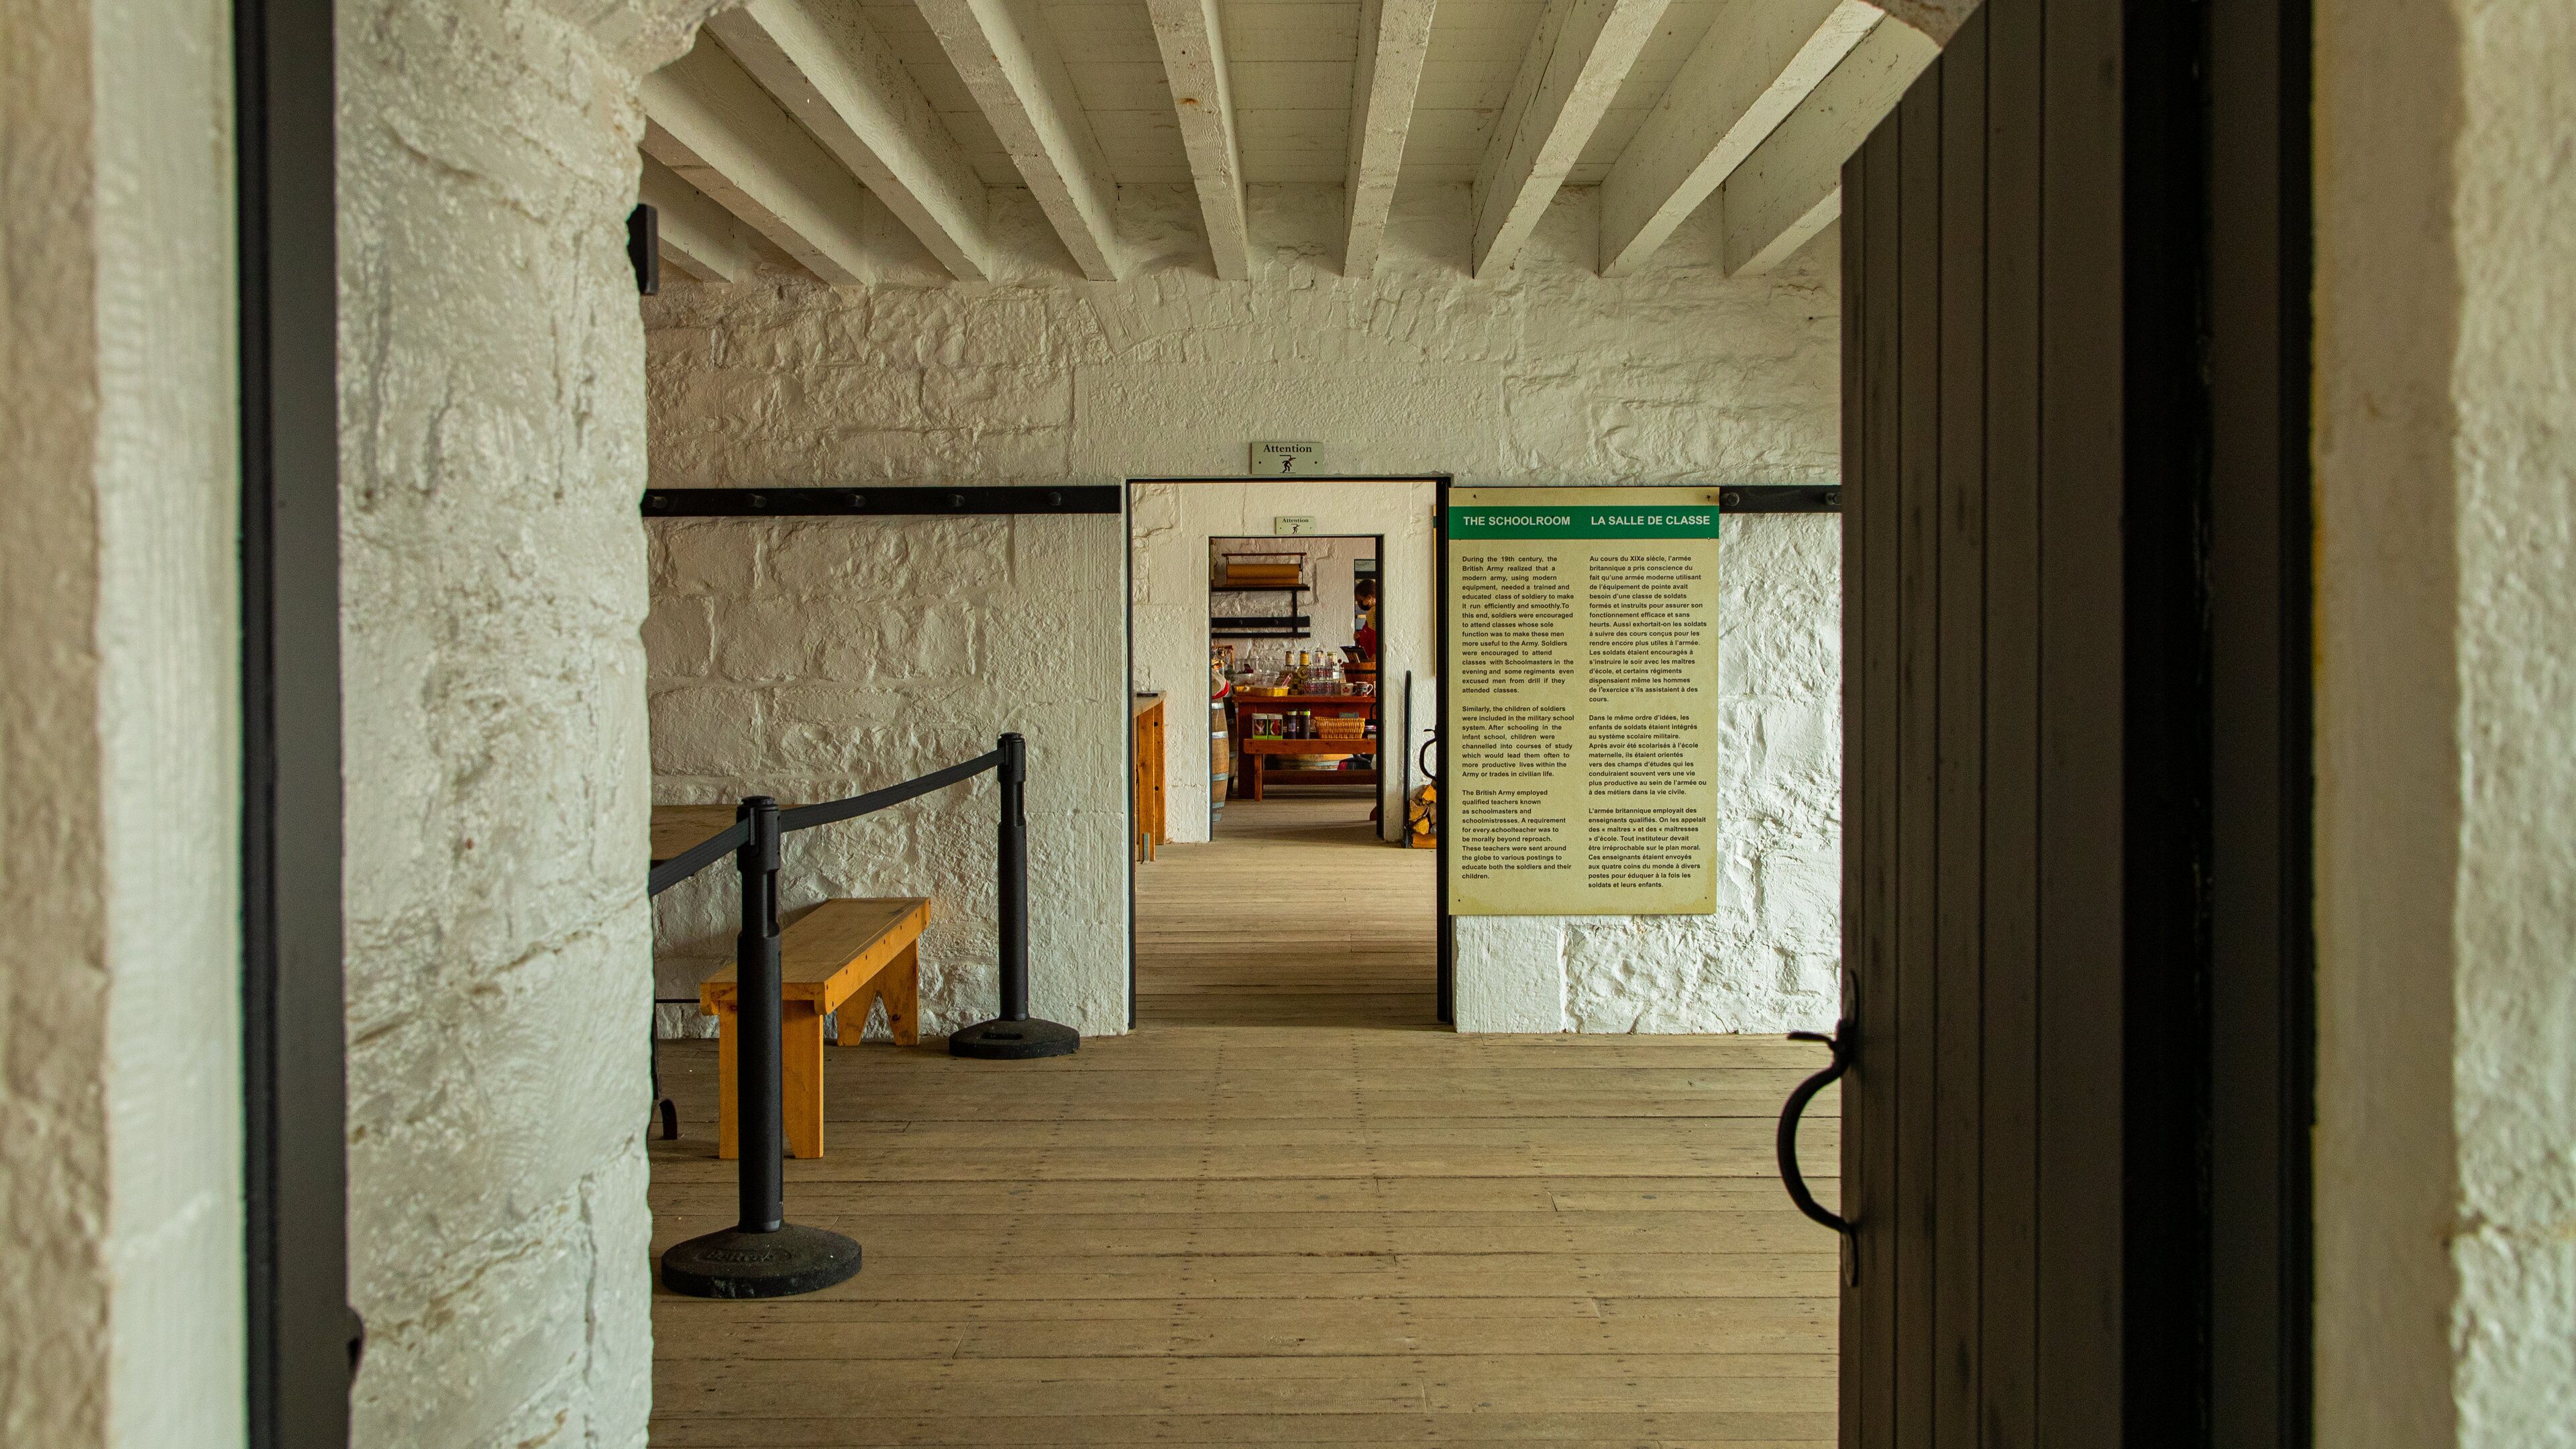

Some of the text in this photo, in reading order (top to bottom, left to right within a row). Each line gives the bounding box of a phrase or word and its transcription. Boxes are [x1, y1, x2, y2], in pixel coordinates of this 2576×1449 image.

[1263, 444, 1313, 453] Attention
[1463, 516, 1571, 526] THE SCHOOLROOM
[1591, 515, 1711, 525] LA SALLE DE CLASSE
[1521, 593, 1548, 601] soldiery
